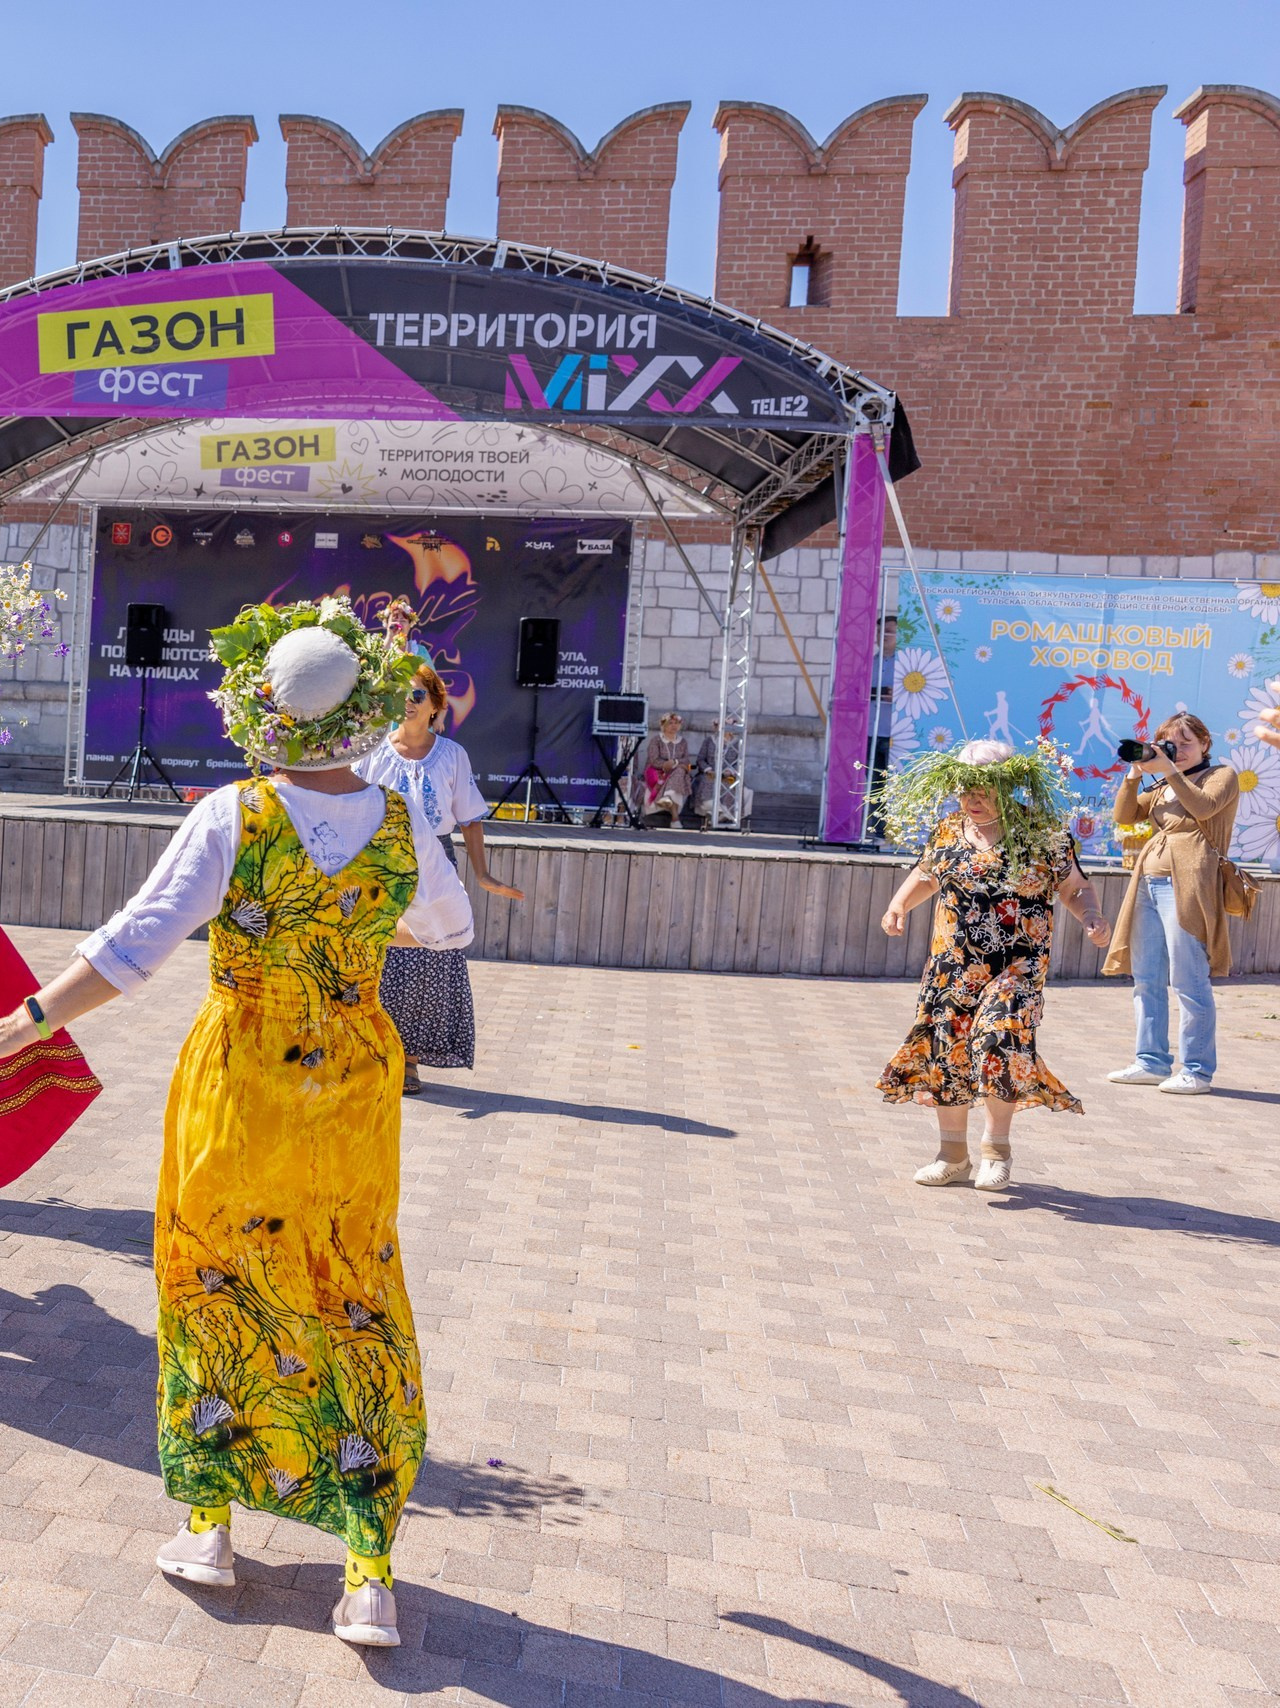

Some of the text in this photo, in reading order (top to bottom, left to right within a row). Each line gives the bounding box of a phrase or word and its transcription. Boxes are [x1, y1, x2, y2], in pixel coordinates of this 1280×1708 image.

[66, 307, 245, 360] ГАЗОН
[369, 312, 657, 349] ТЕРРИТОРИЯ
[98, 366, 203, 403] фест
[751, 395, 809, 417] TELE2
[216, 434, 320, 463] ГАЗОН
[379, 448, 530, 464] ТЕРРИТОРИЯ ТВОЕЙ
[234, 466, 295, 487] фест
[400, 468, 505, 484] МОЛОДОСТИ
[587, 543, 612, 551] БАЗА
[956, 588, 1026, 598] РЕГИОНАЛЬНАЯ
[1162, 597, 1236, 605] ОБЩЕСТВЕННАЯ
[1029, 599, 1082, 608] ОБЛАСТНАЯ
[1084, 602, 1138, 612] ФЕДЕРАЦИЯ
[1140, 603, 1188, 612] СЕВЕРНОЙ
[991, 620, 1212, 649] РОМАШКОВЫЙ
[1030, 645, 1174, 676] ХОРОВОД
[109, 664, 199, 681] НА УЛИЦАХ
[86, 754, 114, 762] панна
[161, 758, 199, 767] воркаут
